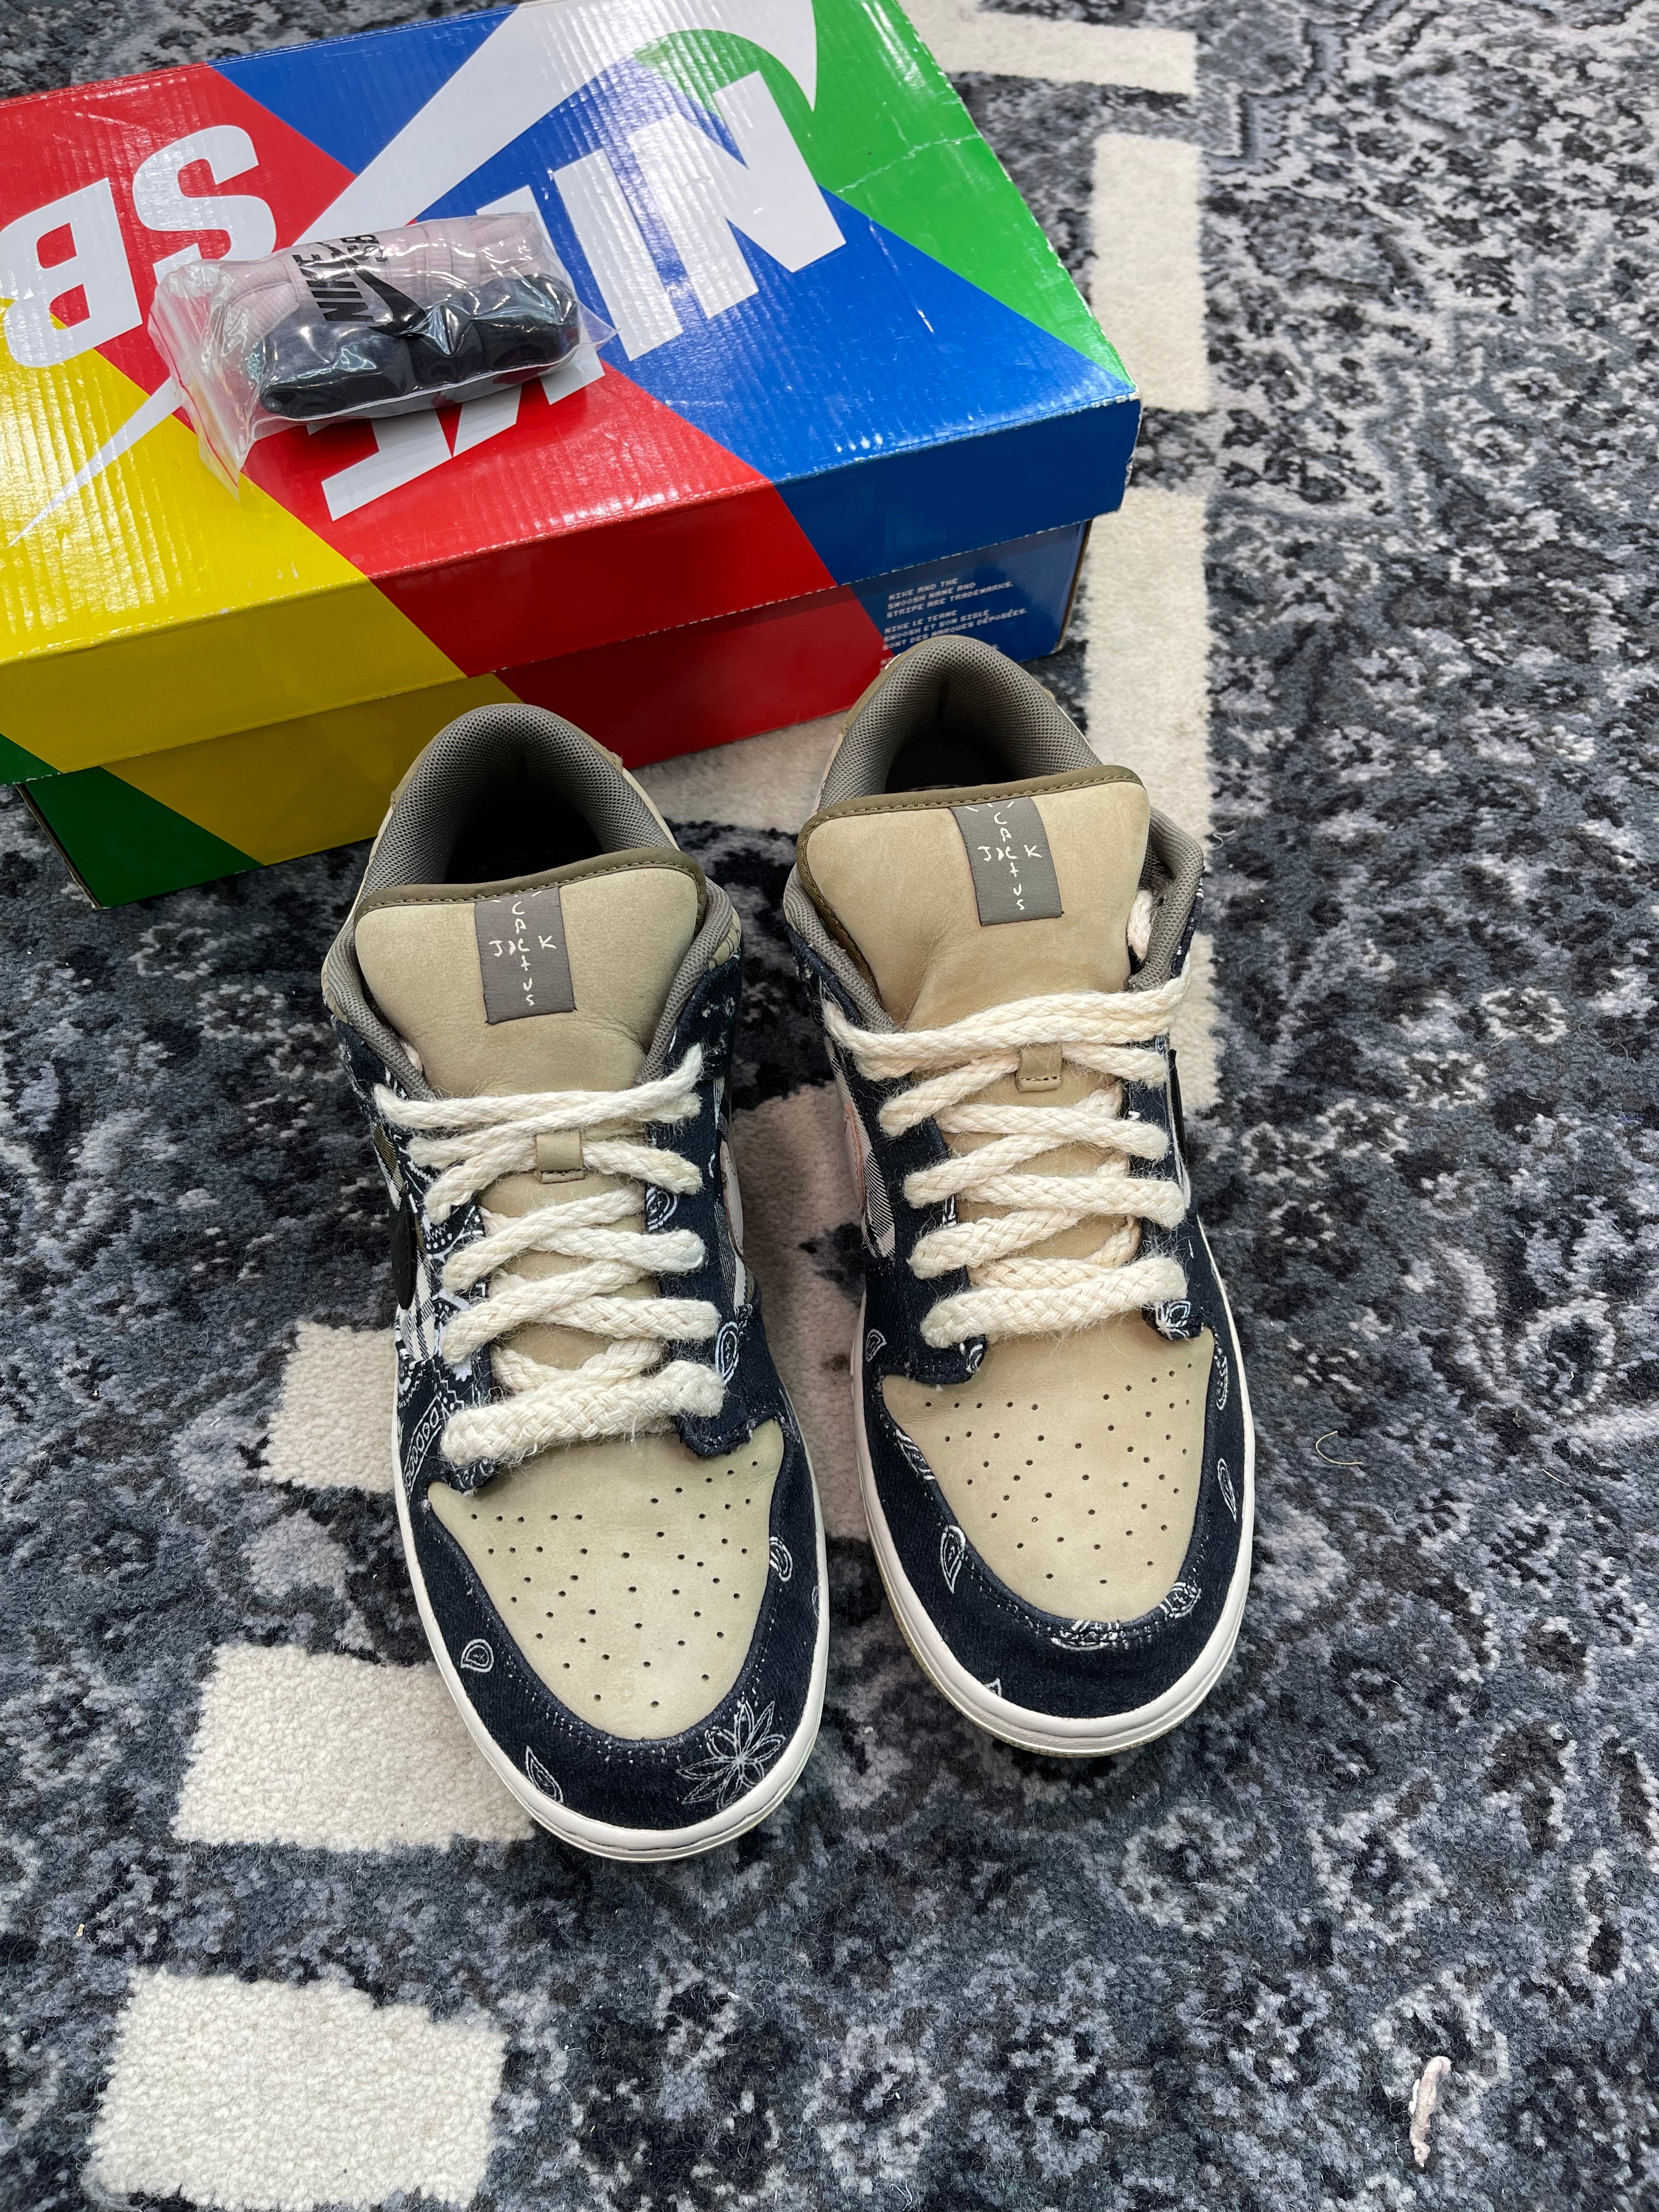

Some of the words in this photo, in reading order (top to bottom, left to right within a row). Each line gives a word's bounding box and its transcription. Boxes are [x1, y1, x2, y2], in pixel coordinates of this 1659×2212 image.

[0, 125, 276, 368] SB
[292, 254, 375, 323] NIKE
[306, 71, 846, 521] NI
[886, 603, 924, 618] STRIPE
[927, 598, 946, 607] ARE
[950, 582, 1014, 602] TRADEMARKS.
[887, 595, 926, 610] SWOOSH
[928, 588, 954, 599] NAME
[957, 582, 976, 591] AND
[888, 589, 914, 601] NIKE
[917, 583, 936, 593] AND
[940, 578, 958, 588] THE
[883, 627, 921, 642] SWOOSH
[923, 623, 936, 632] ET
[939, 618, 958, 628] SON
[960, 610, 990, 622] SIGLE
[884, 622, 910, 634] NIKE
[912, 618, 924, 627] LE
[927, 610, 958, 622] TERME
[882, 639, 907, 651] SONT
[910, 633, 929, 644] DES
